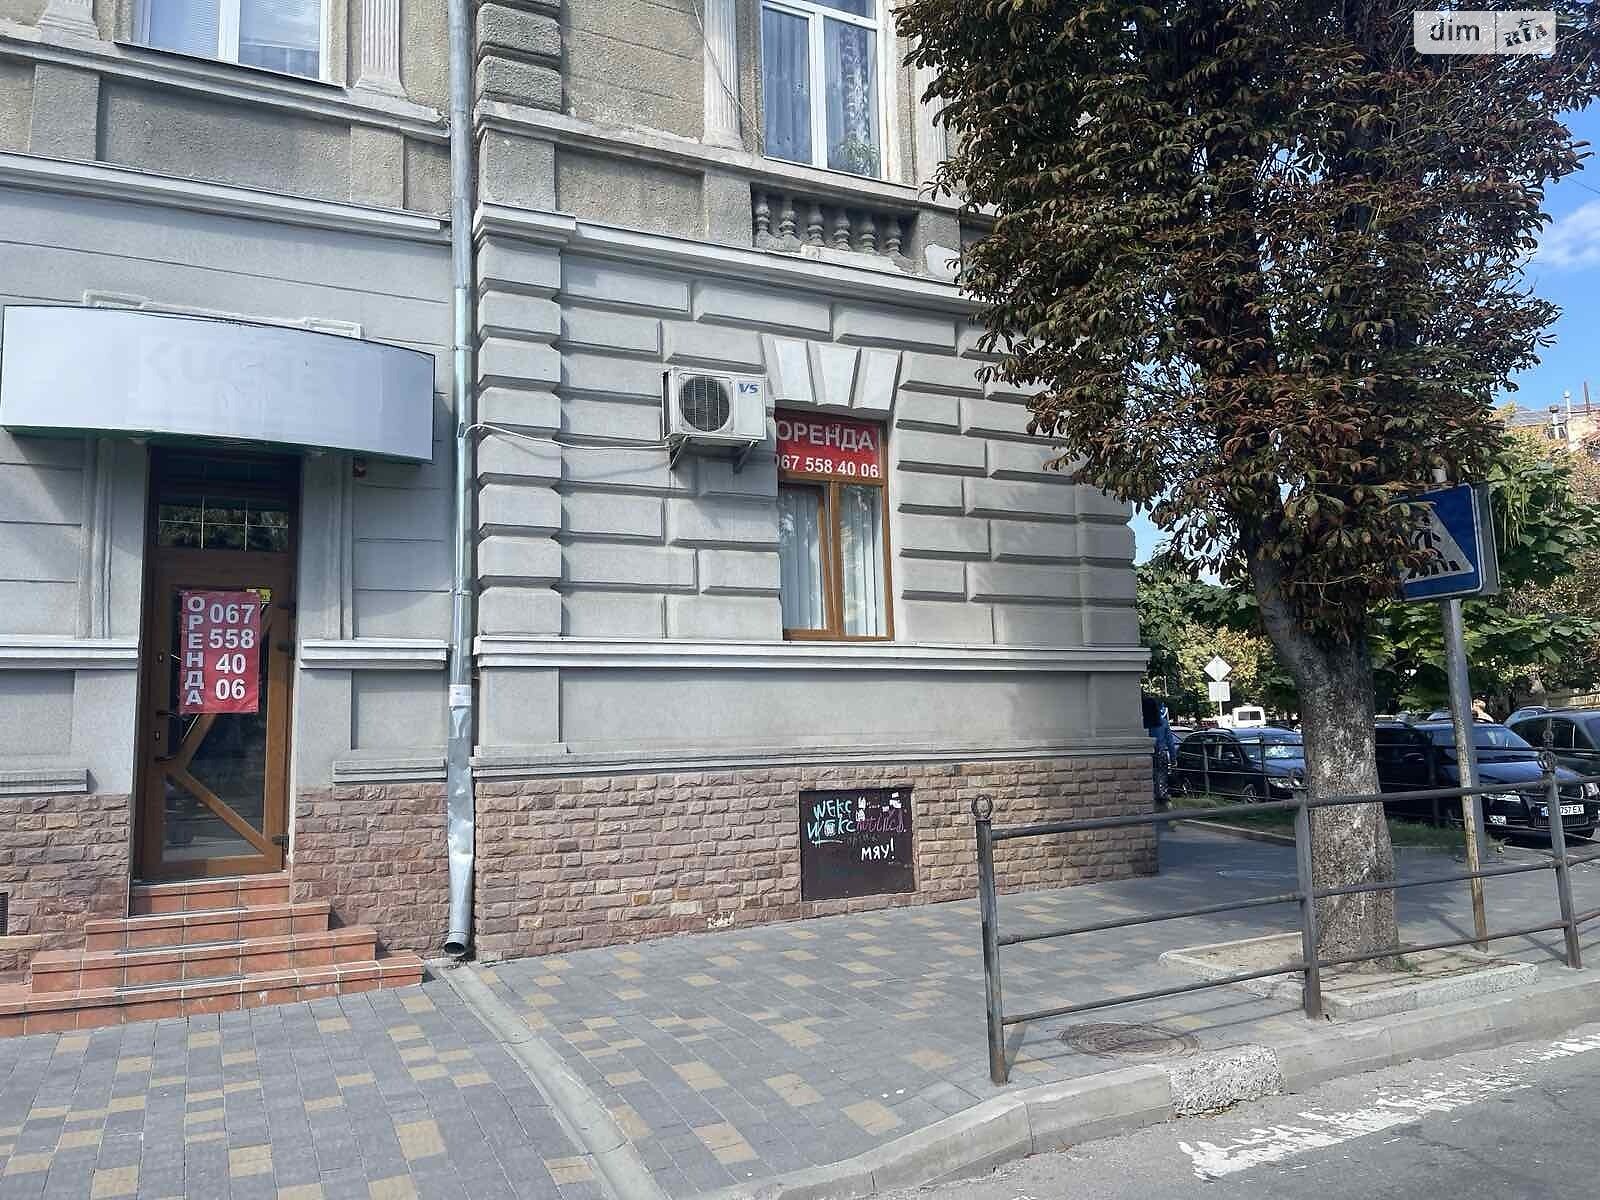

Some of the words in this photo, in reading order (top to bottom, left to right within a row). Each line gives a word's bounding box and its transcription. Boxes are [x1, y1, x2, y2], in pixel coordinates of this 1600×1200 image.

[776, 420, 874, 452] ОРЕНДА
[775, 454, 800, 471] 67
[805, 457, 833, 473] 558
[837, 460, 856, 475] 40
[860, 463, 879, 478] 06
[209, 603, 256, 624] 067
[209, 628, 255, 649] 558
[184, 596, 206, 705] ОРЕНДА
[215, 653, 247, 674] 40
[215, 678, 247, 700] 06
